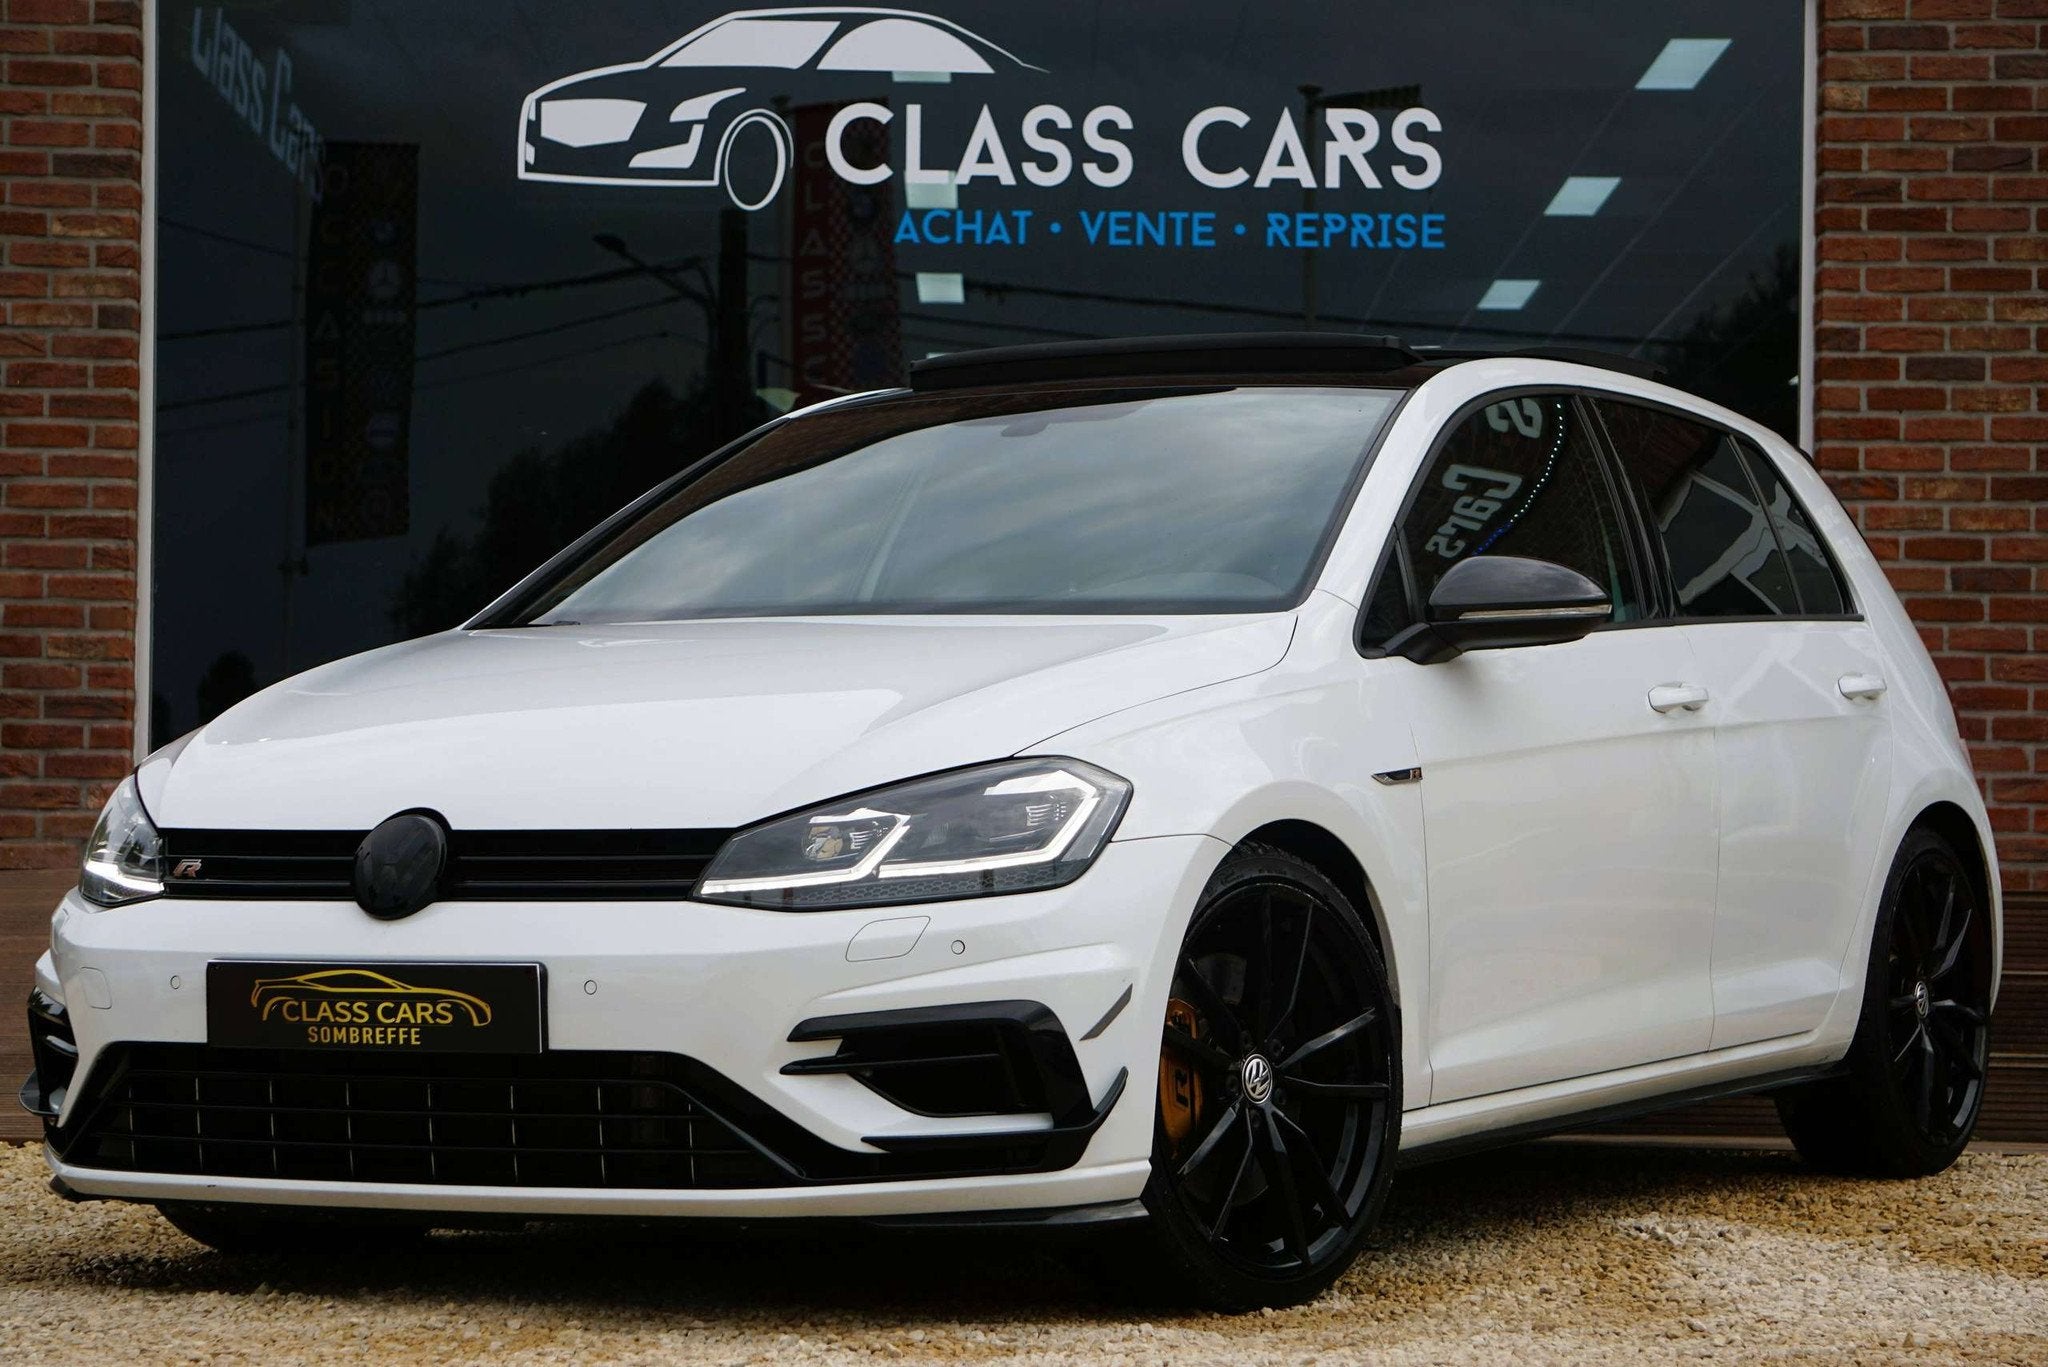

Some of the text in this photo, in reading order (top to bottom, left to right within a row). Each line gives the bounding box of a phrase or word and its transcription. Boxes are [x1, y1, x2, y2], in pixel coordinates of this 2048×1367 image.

[826, 103, 1442, 189] CLASS CARS
[894, 208, 1446, 249] ACHAT VENTE REPRISE
[282, 1000, 453, 1024] CLASS CARS
[308, 1026, 421, 1045] SOMBREFFE
